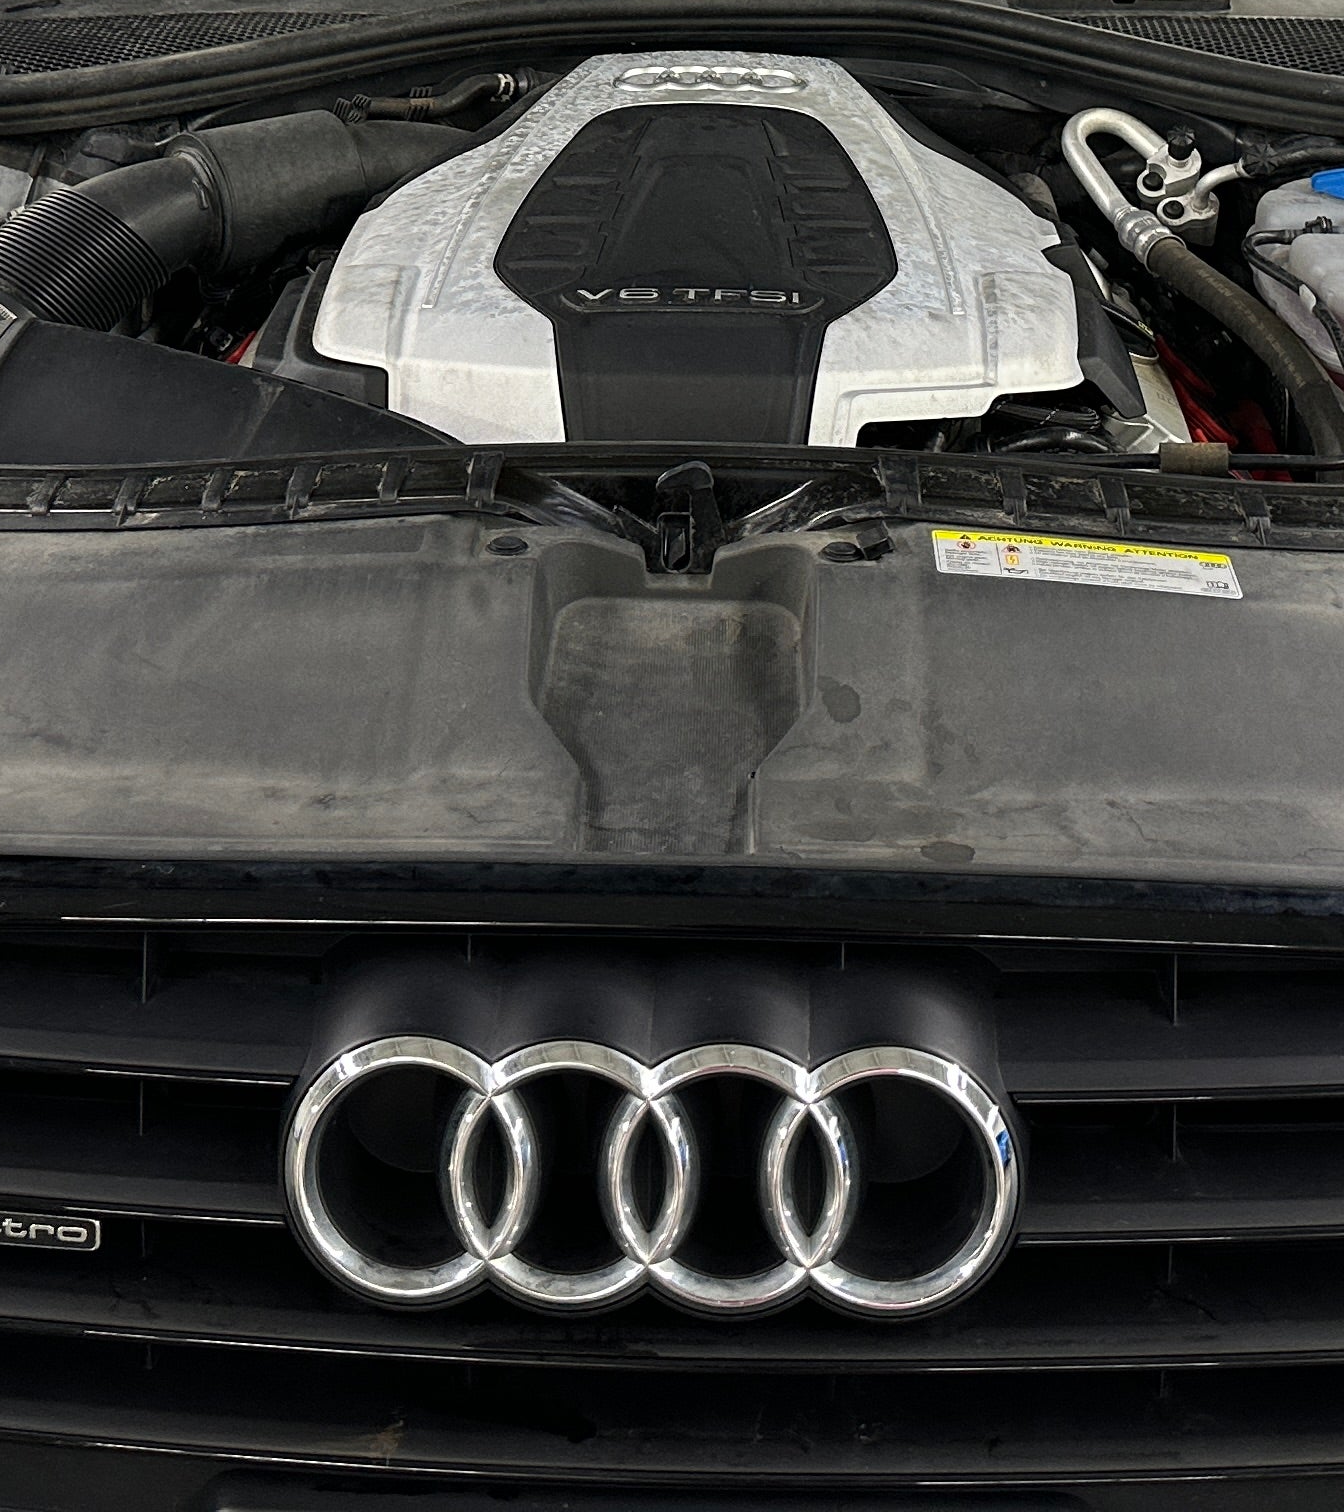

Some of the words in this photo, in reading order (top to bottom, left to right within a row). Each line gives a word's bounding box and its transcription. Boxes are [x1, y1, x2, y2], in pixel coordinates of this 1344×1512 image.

[576, 288, 659, 300] V6
[672, 288, 799, 304] TFSI
[978, 535, 1044, 545] ACHTUNG
[1051, 541, 1117, 552] WARNING
[1124, 548, 1199, 560] ATTENTION
